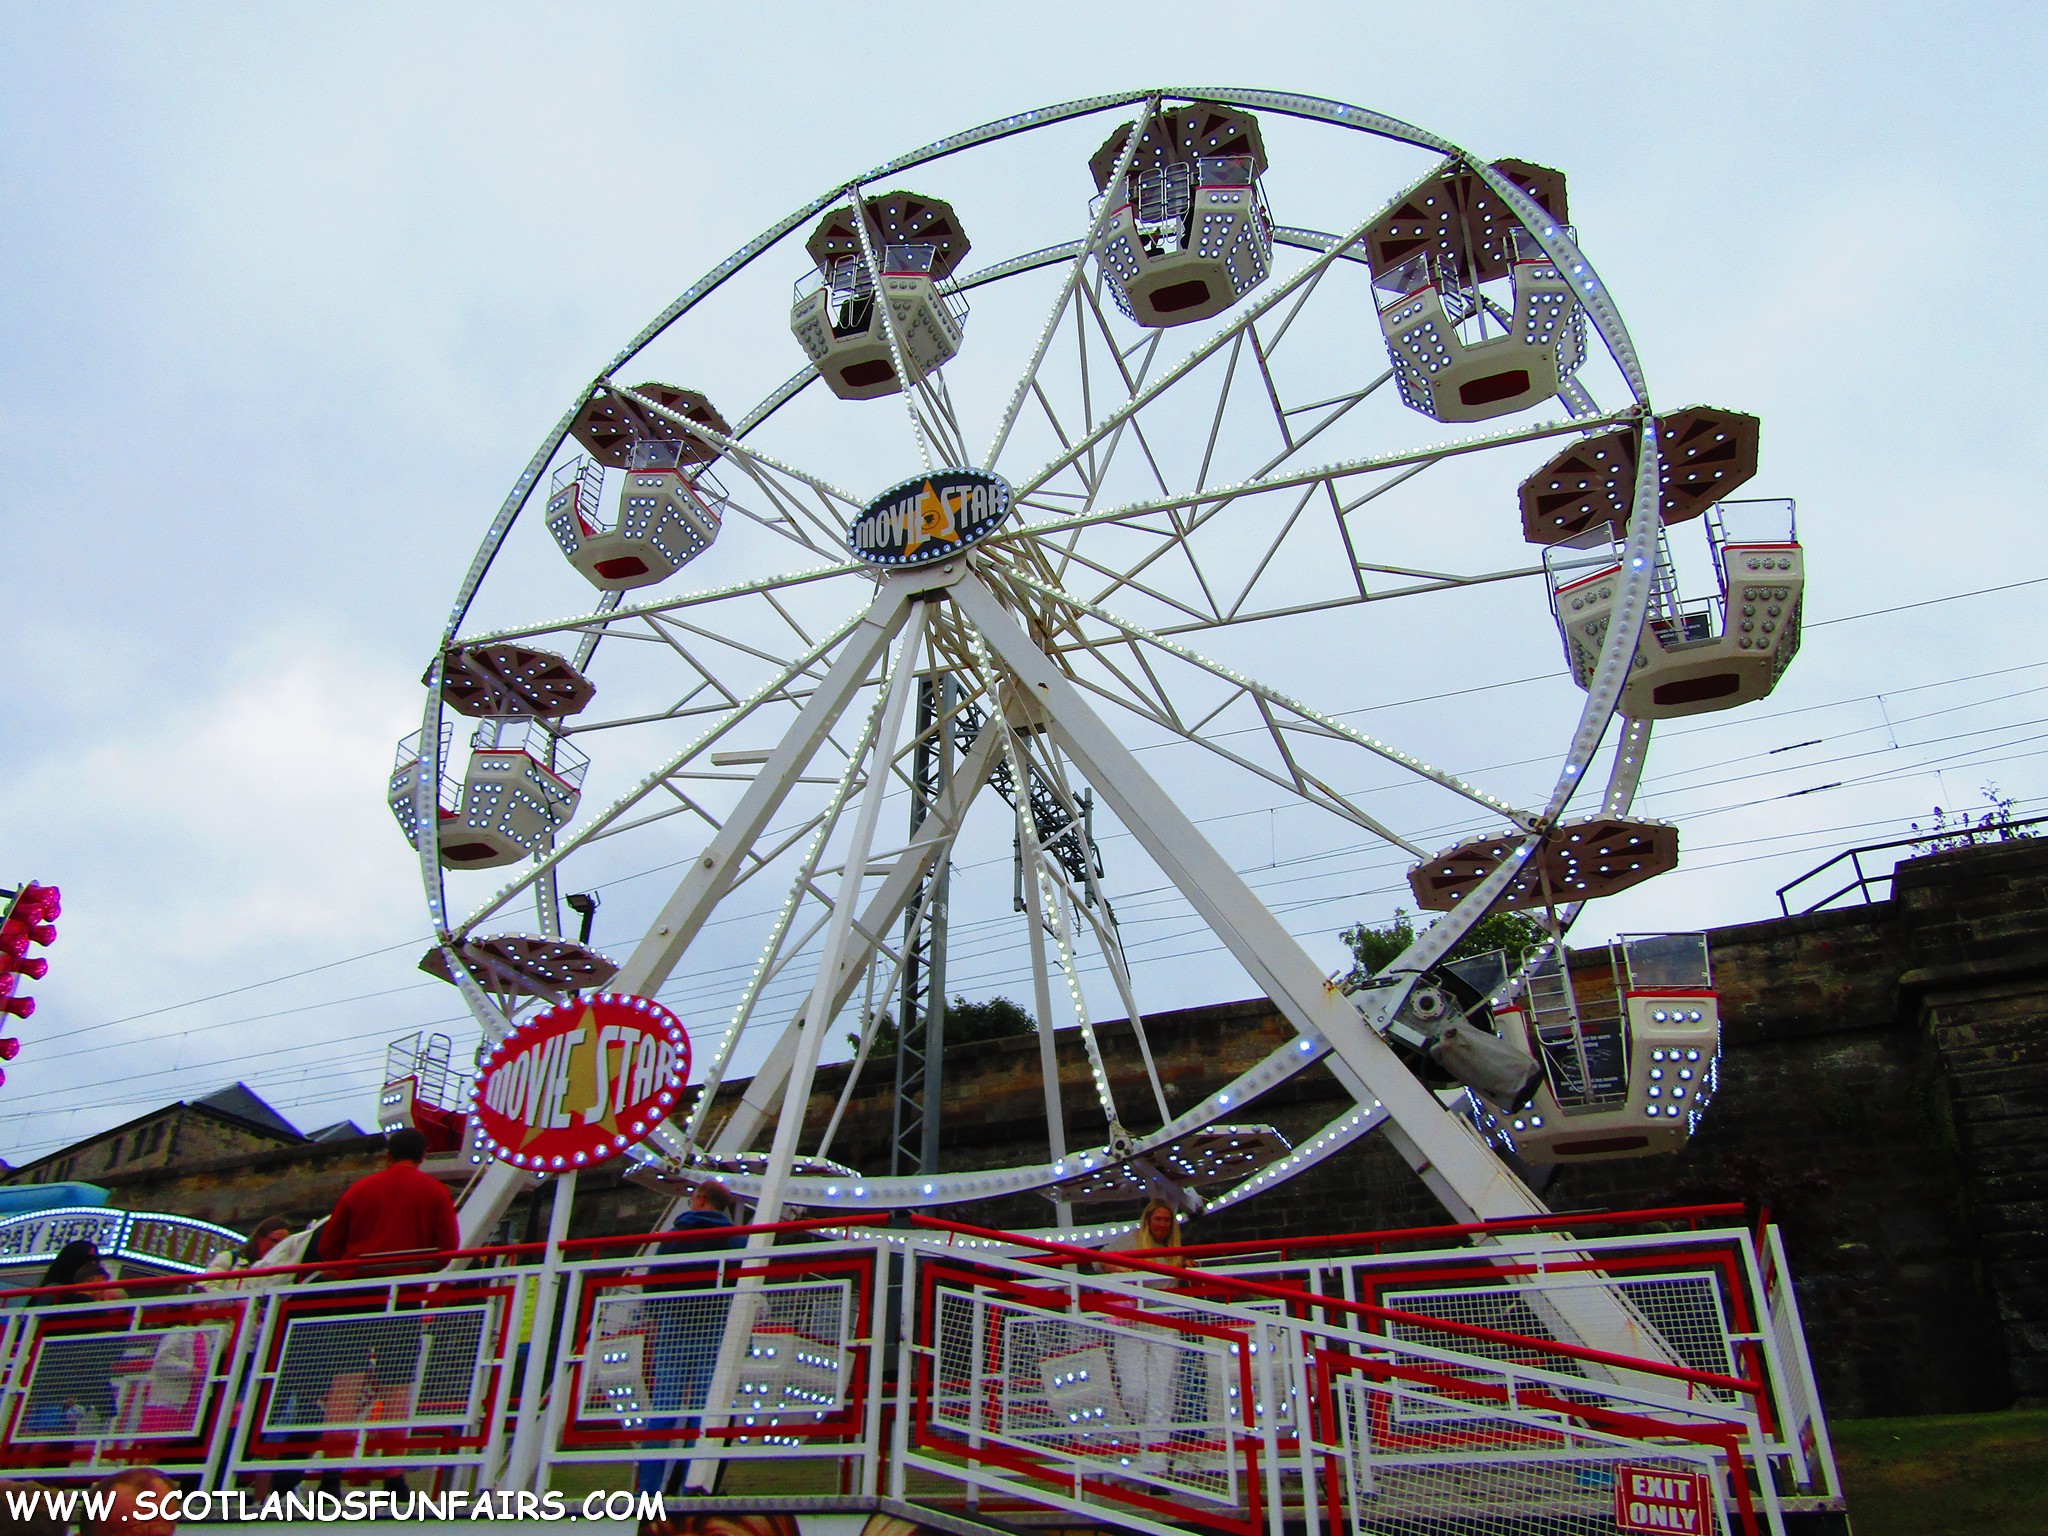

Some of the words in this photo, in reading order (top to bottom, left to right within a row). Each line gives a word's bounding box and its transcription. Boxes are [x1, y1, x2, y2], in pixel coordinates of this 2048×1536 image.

[856, 491, 931, 549] MOVIE
[940, 484, 1006, 538] STAR
[484, 1028, 587, 1130] MOVIE
[583, 1025, 678, 1125] STAR
[1632, 1474, 1690, 1501] EXIT
[1629, 1502, 1696, 1530] ONLY
